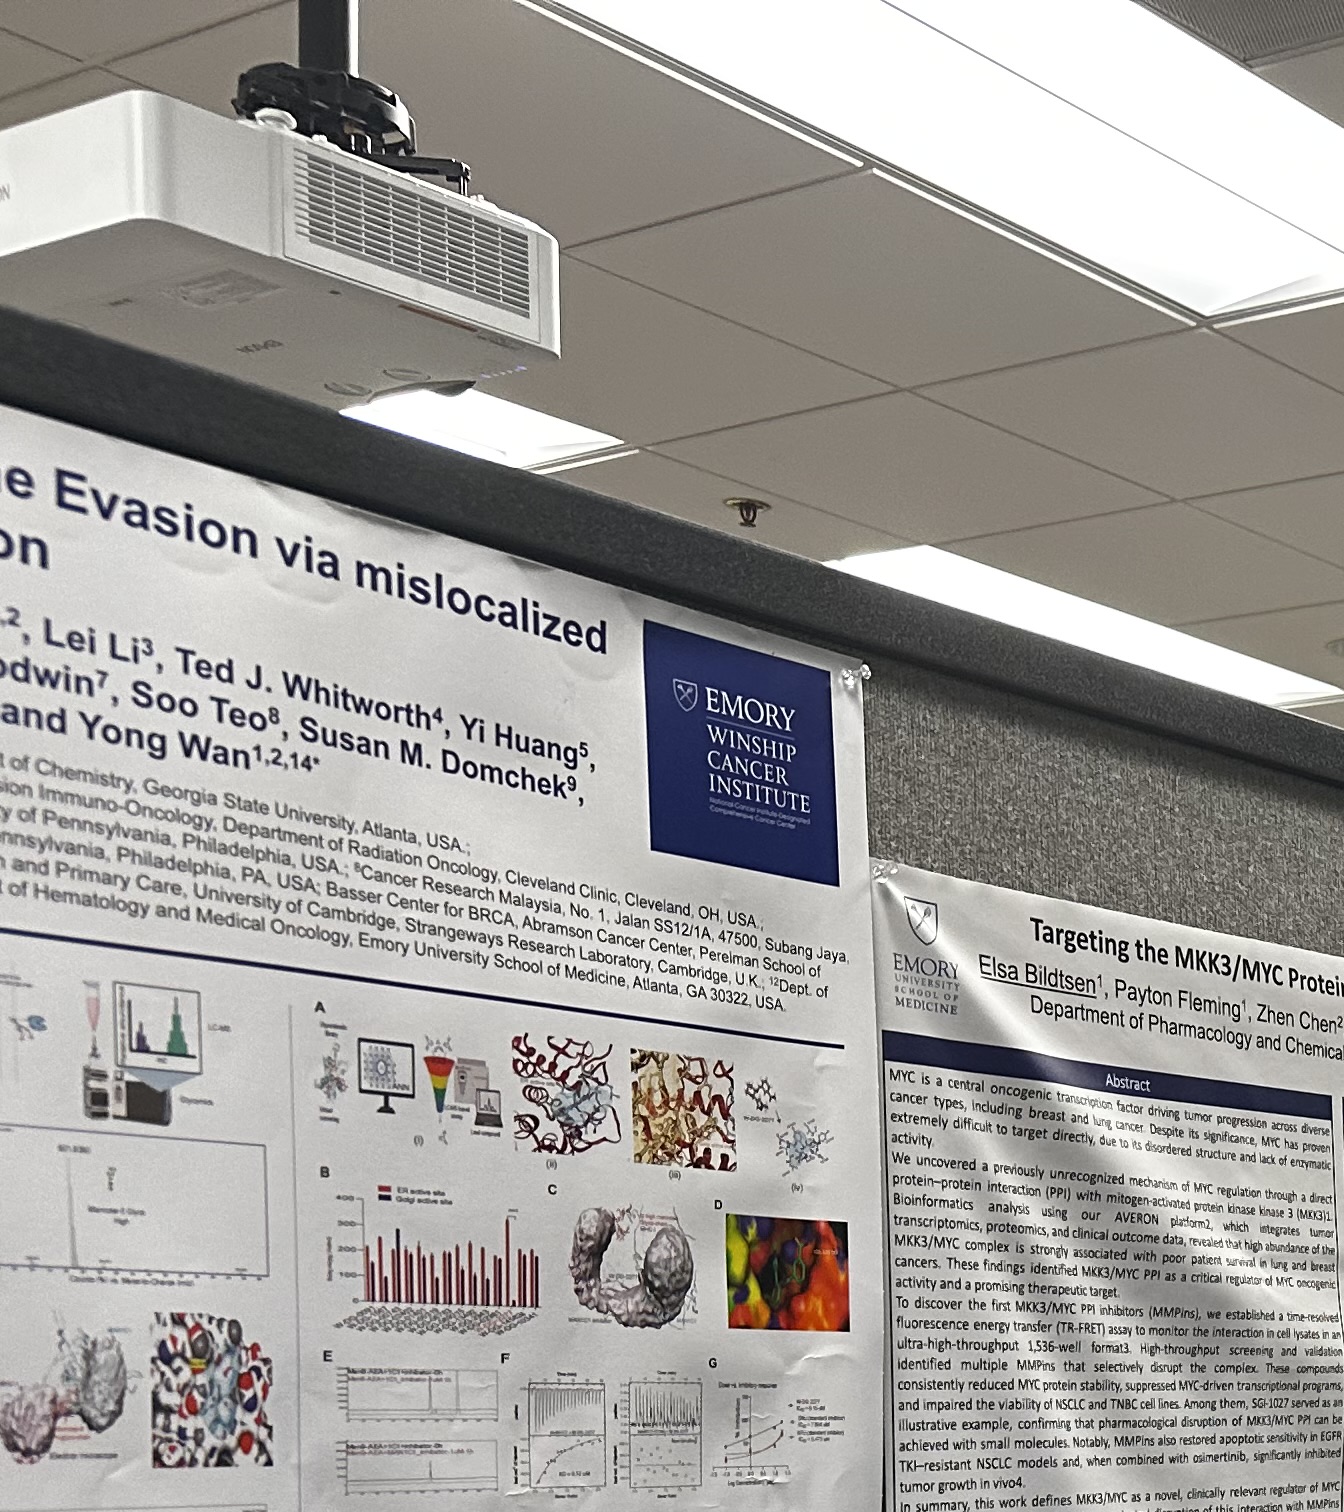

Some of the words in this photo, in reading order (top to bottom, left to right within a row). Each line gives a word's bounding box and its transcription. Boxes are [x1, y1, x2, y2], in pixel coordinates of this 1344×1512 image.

[54, 467, 258, 559] Evasion
[274, 534, 340, 582] via
[355, 559, 609, 655] mislocalized
[43, 618, 96, 655] Lei
[174, 646, 234, 685] Ted
[244, 663, 272, 693] J.
[458, 713, 485, 744] Yi
[0, 702, 68, 735] and
[77, 710, 167, 761] Yong
[130, 679, 199, 718] Soo
[298, 715, 390, 760] Susan
[399, 738, 432, 770] M.
[705, 686, 796, 732] EMORY
[707, 724, 797, 763] WINSHIP
[707, 750, 789, 786] CANCER
[709, 773, 811, 814] INSTITUTE
[6, 880, 30, 898] of
[32, 882, 151, 920] Hematology
[154, 904, 190, 922] and
[195, 906, 266, 932] Medical
[269, 917, 353, 949] Oncology,
[358, 930, 410, 958] Emory
[413, 939, 490, 970] University
[493, 952, 543, 975] School
[546, 962, 561, 977] of
[564, 963, 630, 990] Medicine,
[632, 975, 682, 998] Atlanta,
[686, 983, 708, 1000] GA
[755, 993, 788, 1013] USA.
[893, 952, 958, 980] EMORY
[1031, 916, 1130, 964] Targeting
[1134, 937, 1169, 966] the
[1174, 944, 1284, 986] MKK3/MYC
[894, 973, 960, 991] UNIVERSITY
[895, 995, 958, 1015] MEDICINE
[978, 952, 1020, 983] Elsa
[1114, 977, 1173, 1008] Payton
[1256, 1002, 1297, 1028] Zhen
[1030, 995, 1125, 1028] Department
[1128, 1011, 1145, 1031] of
[1148, 1013, 1253, 1051] Pharmacology
[1255, 1033, 1281, 1052] and
[1105, 1072, 1151, 1093] Abstract
[899, 1481, 936, 1494] tumor
[937, 1477, 977, 1495] growth
[979, 1477, 990, 1489] in
[992, 1475, 1026, 1489] vivo4.
